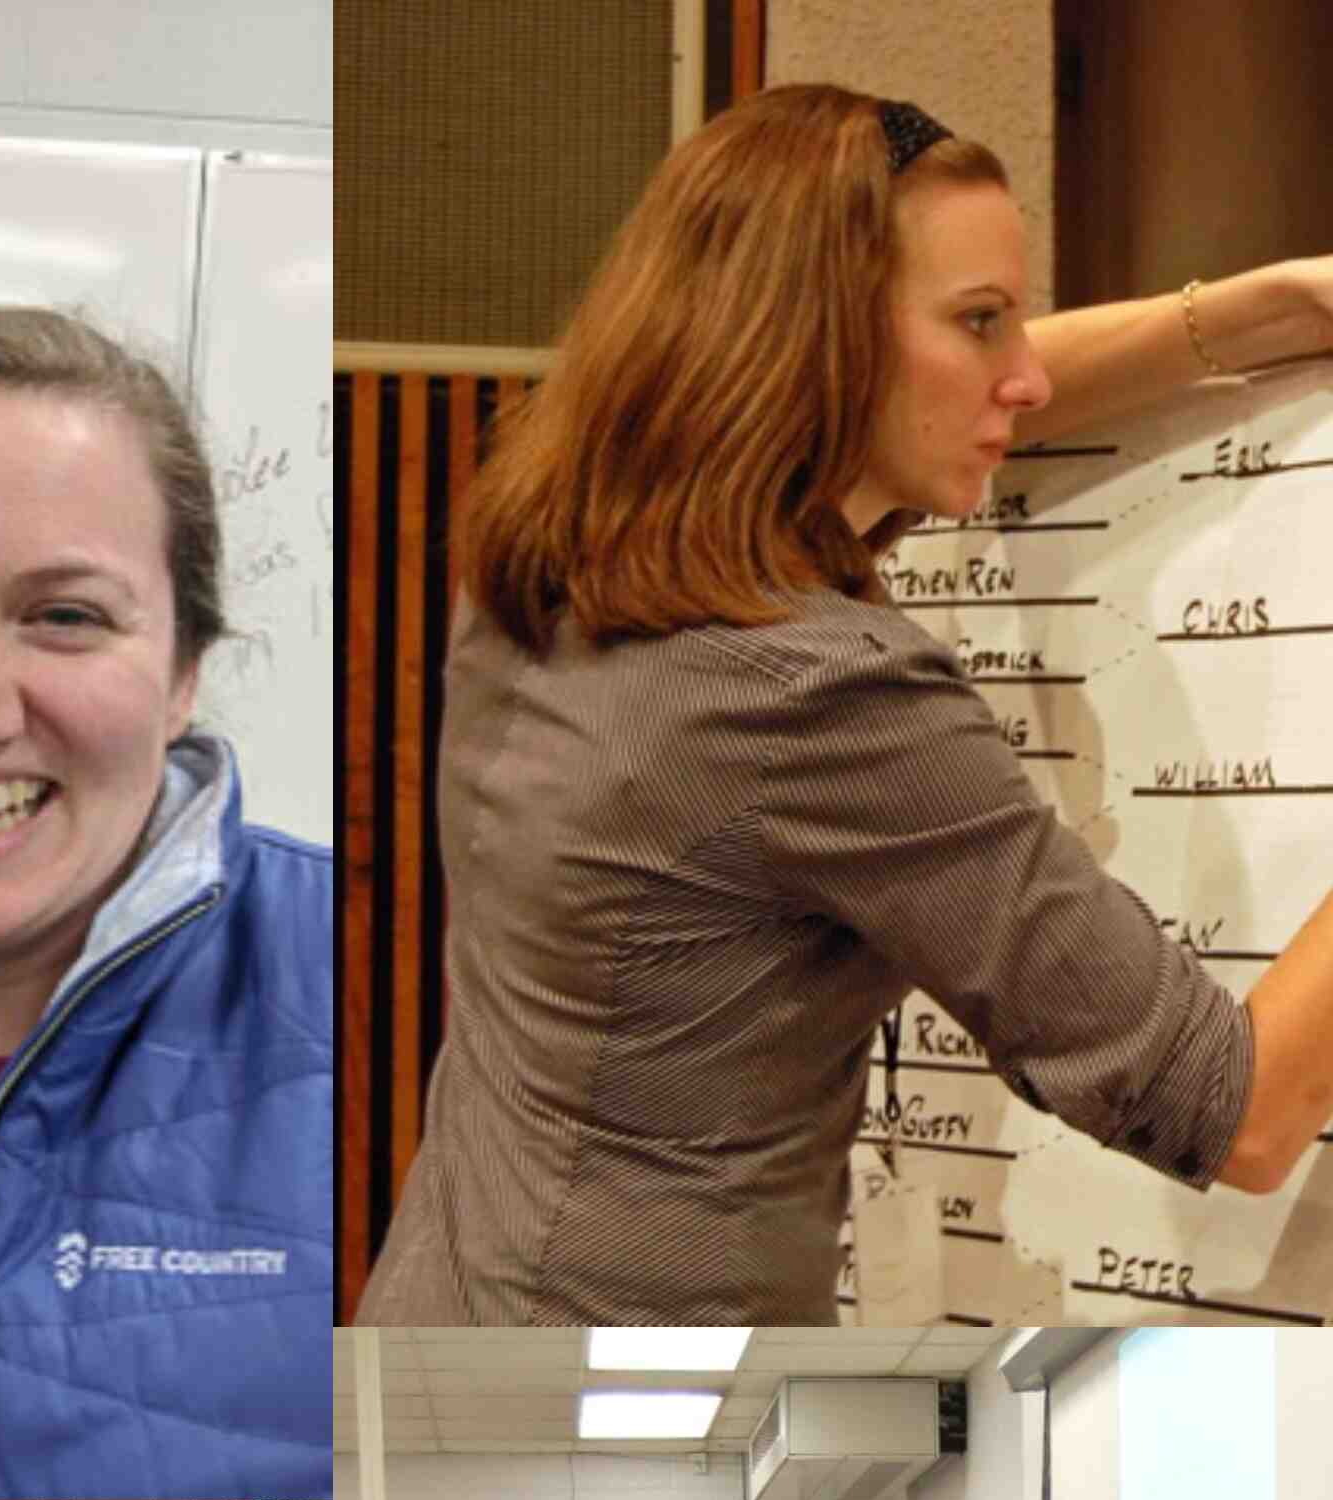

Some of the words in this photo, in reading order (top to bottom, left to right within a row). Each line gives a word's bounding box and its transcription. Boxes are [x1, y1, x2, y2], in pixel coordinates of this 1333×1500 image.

[966, 558, 1015, 597] REN
[1182, 598, 1271, 635] CHRIS
[1154, 757, 1277, 788] WILLIAM
[90, 1245, 158, 1270] FREE
[1097, 1247, 1197, 1299] PETER
